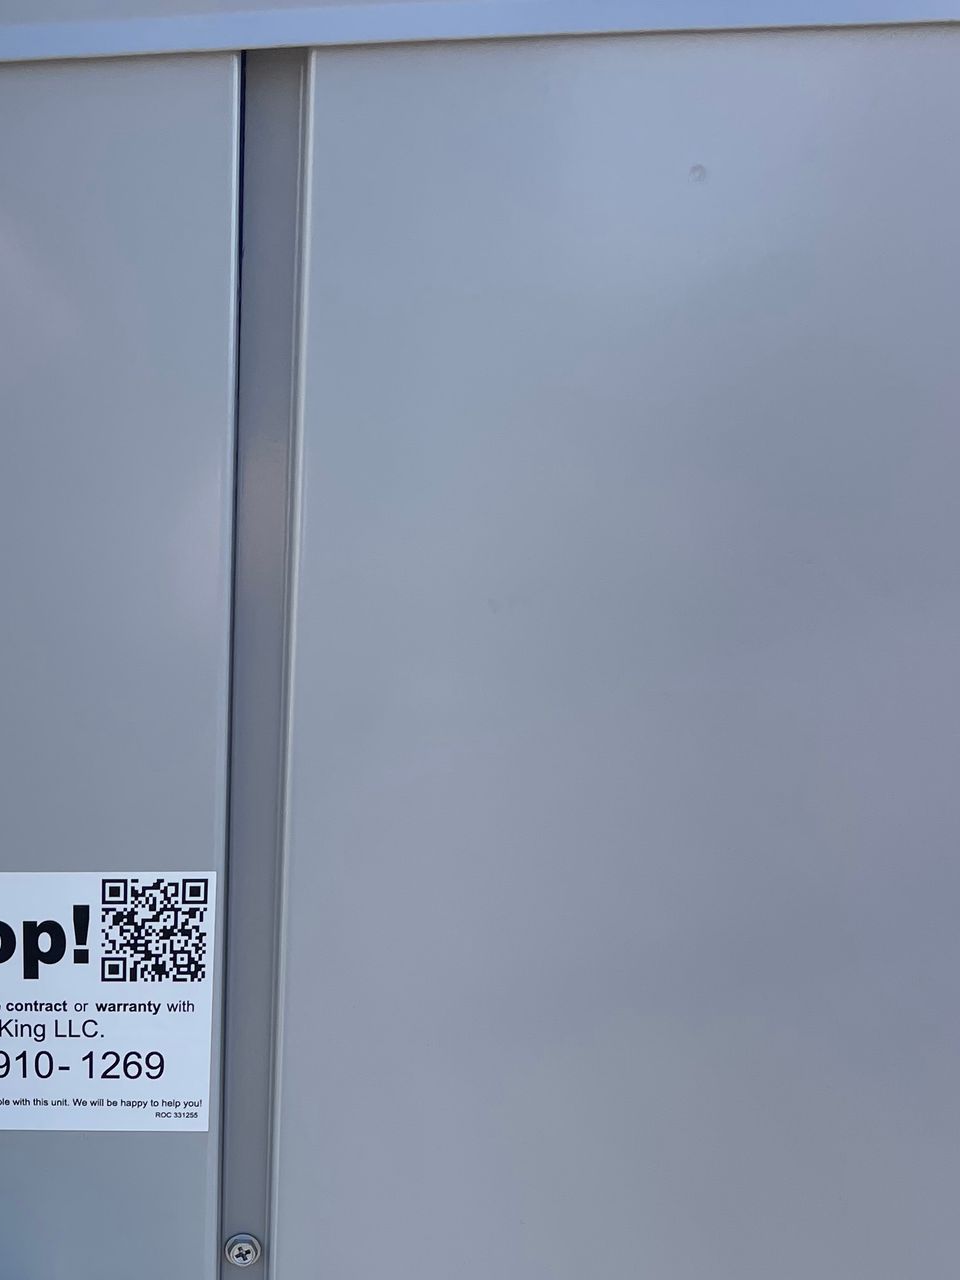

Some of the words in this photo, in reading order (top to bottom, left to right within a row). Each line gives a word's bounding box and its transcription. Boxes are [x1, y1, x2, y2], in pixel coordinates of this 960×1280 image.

[6, 1000, 68, 1012] contract
[74, 1002, 88, 1012] or
[96, 1001, 161, 1015] warranty
[167, 1001, 195, 1013] with
[54, 1019, 105, 1038] LLC.
[12, 1098, 31, 1106] with
[33, 1098, 49, 1107] this
[51, 1098, 70, 1107] unit.
[73, 1099, 88, 1107] We
[90, 1098, 104, 1107] will
[107, 1098, 118, 1107] be
[120, 1099, 148, 1109] happy
[150, 1099, 159, 1108] to
[161, 1099, 181, 1109] help
[183, 1099, 203, 1109] you!
